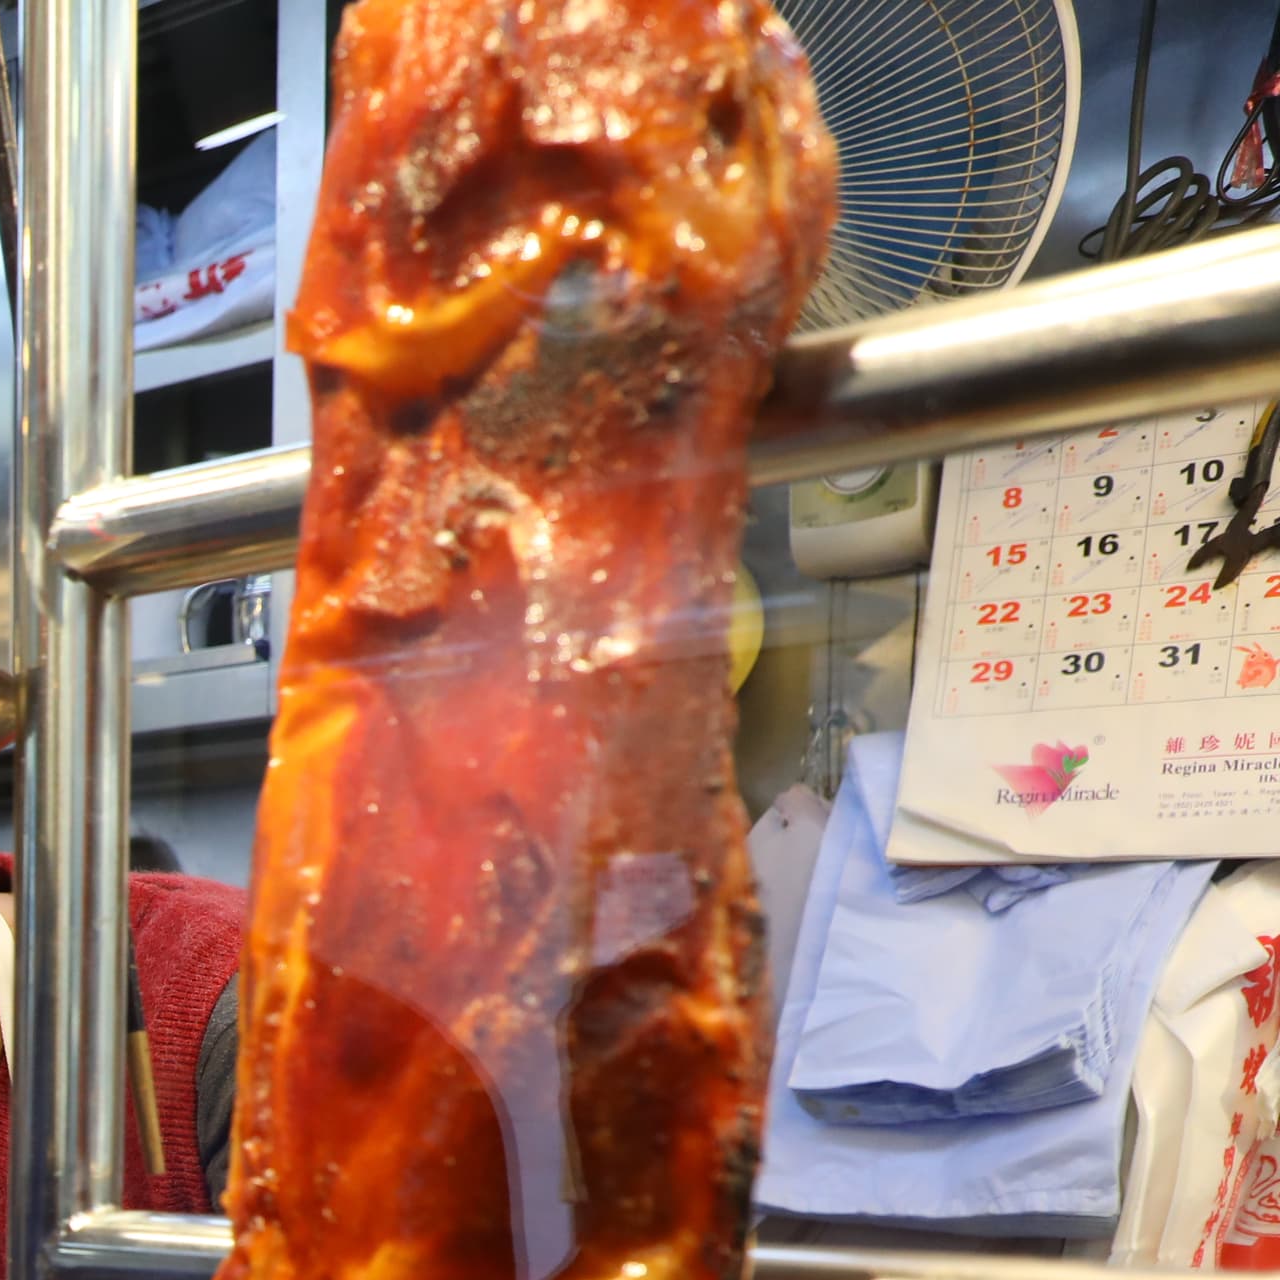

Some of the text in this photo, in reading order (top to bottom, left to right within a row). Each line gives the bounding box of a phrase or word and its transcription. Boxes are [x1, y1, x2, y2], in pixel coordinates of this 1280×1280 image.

[1002, 459, 1225, 509] 8 9 10
[986, 521, 1219, 567] 15 16 17
[976, 574, 1280, 625] 22 23 24 2
[970, 642, 1202, 684] 29 30 31
[1162, 762, 1217, 776] Regina
